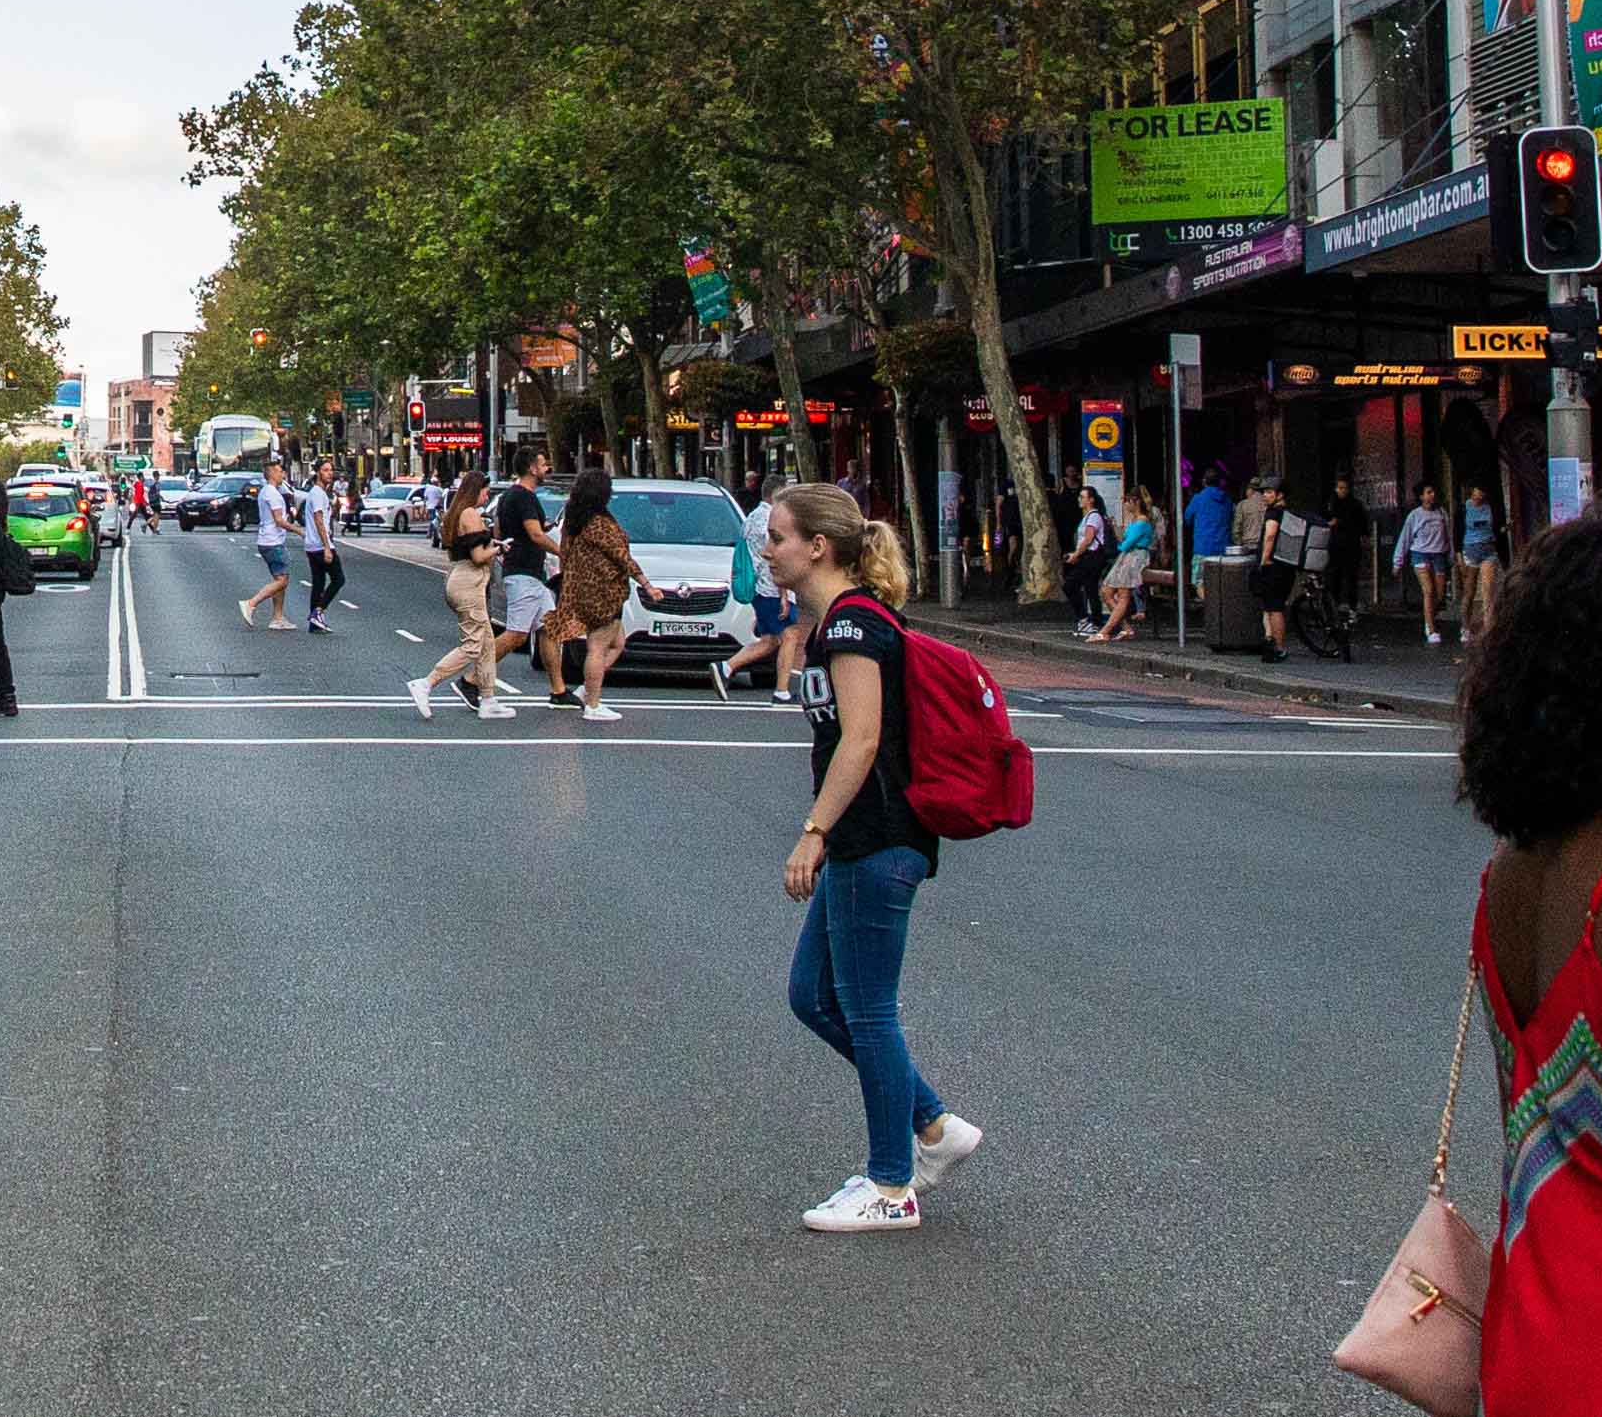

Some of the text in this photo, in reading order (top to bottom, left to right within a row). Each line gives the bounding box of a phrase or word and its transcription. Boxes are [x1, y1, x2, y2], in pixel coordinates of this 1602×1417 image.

[1107, 107, 1273, 140] FOR LEASE
[1180, 223, 1243, 240] 1300 458
[1193, 254, 1267, 290] SPORTS NUTRITION
[836, 619, 854, 627] EST.
[825, 626, 864, 641] 1989
